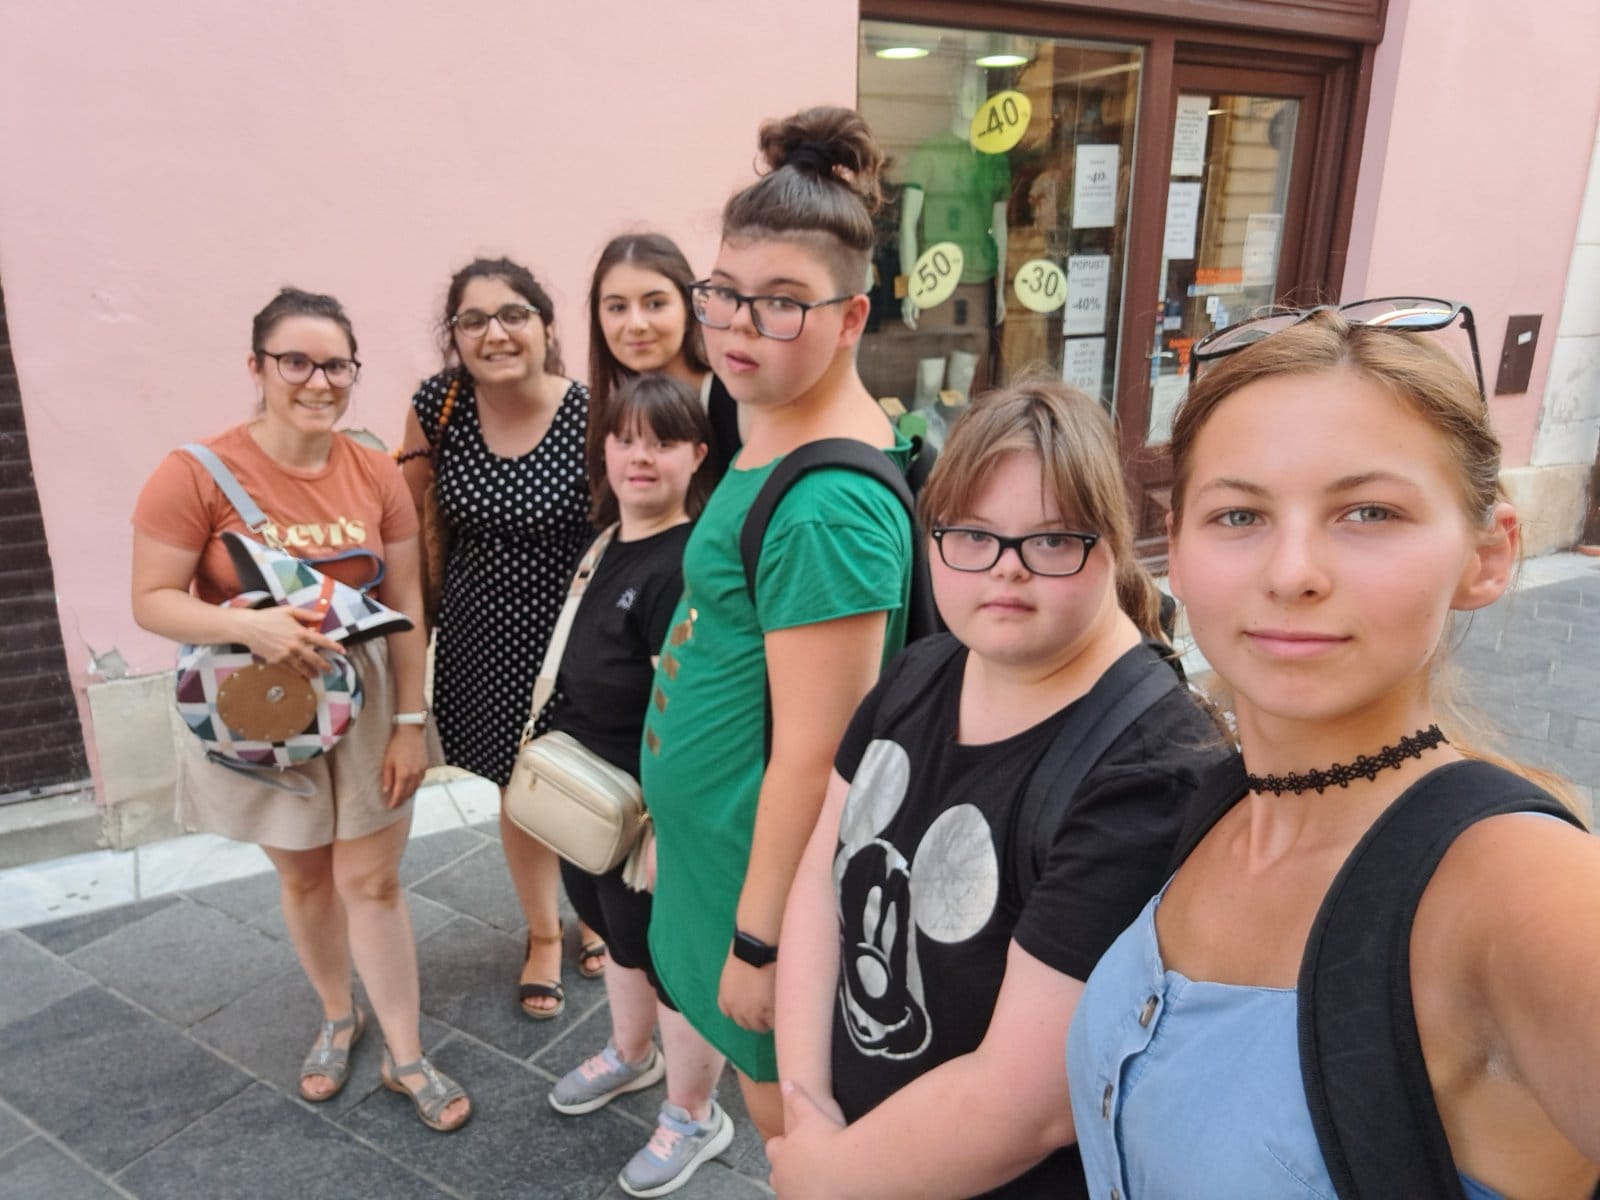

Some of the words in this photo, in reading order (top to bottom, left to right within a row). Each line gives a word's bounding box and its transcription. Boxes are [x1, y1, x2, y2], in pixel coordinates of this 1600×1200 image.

[978, 97, 1019, 137] -40
[917, 251, 951, 297] -50
[1021, 266, 1059, 298] -30
